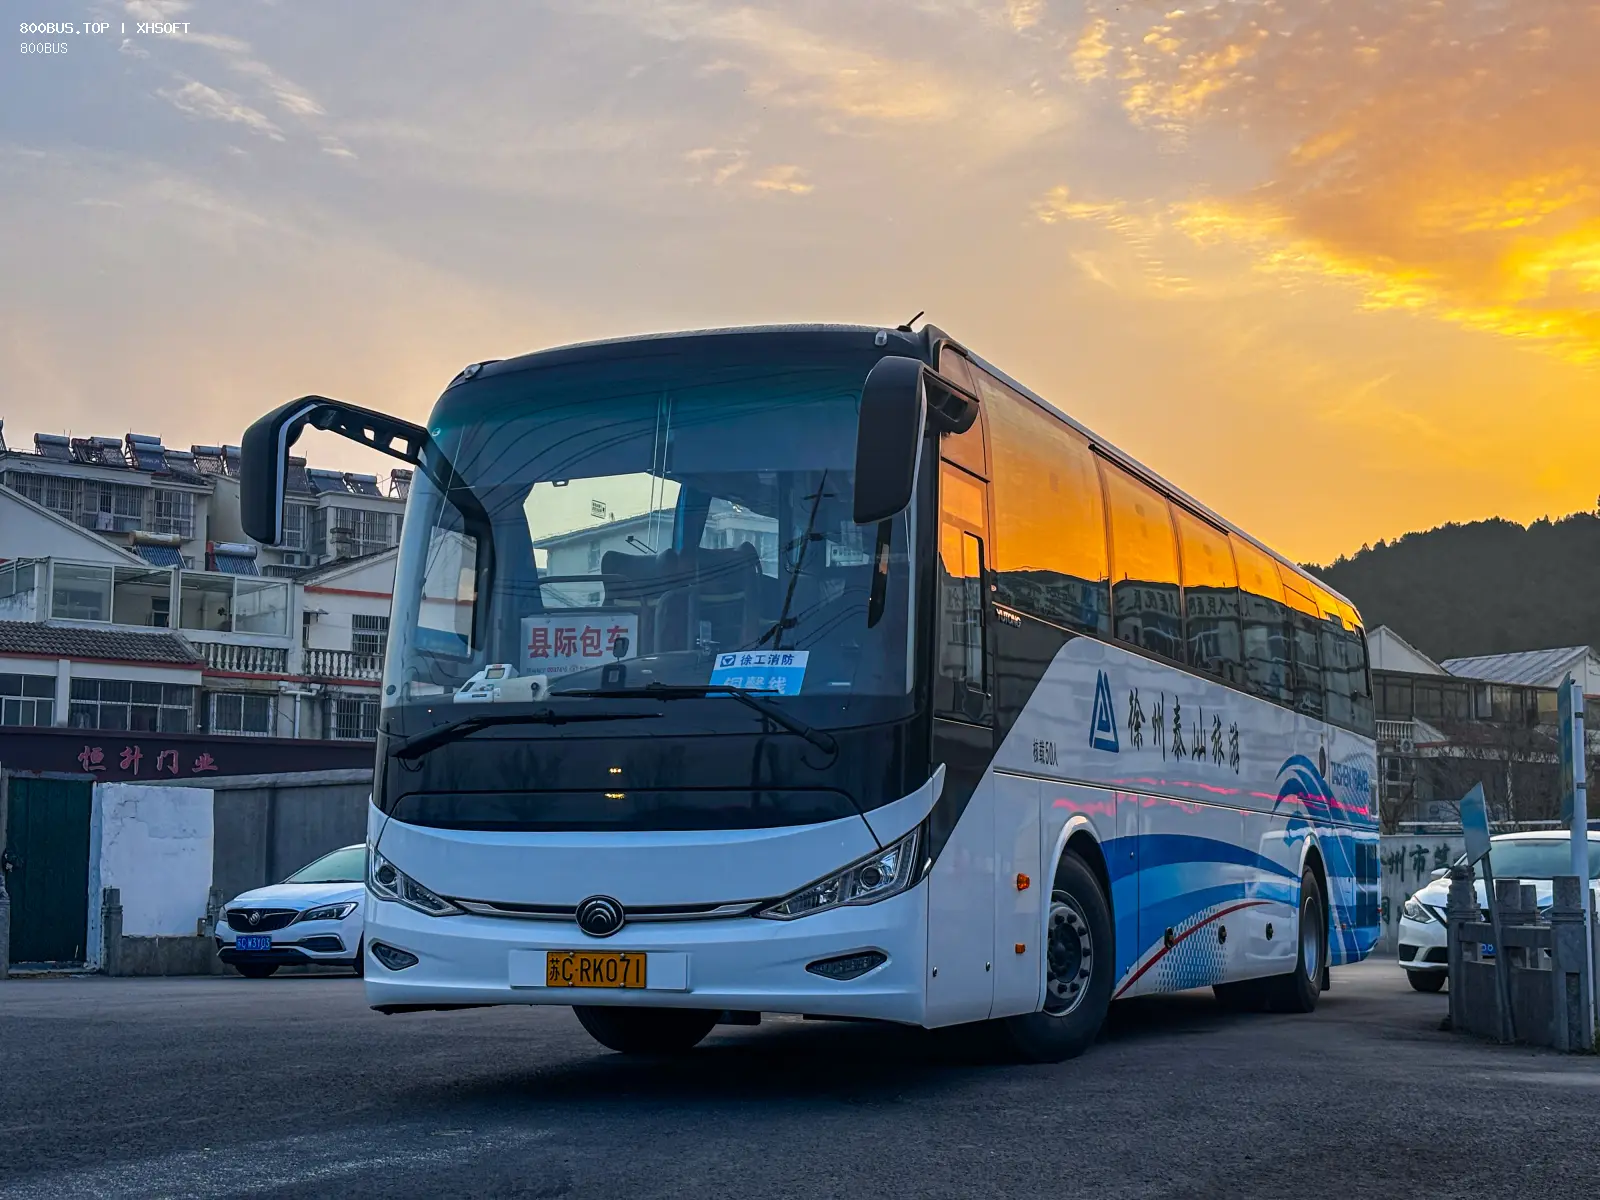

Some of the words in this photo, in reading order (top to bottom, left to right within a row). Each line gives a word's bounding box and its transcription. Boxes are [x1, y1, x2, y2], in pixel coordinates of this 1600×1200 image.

[527, 625, 629, 659] 县际包车
[740, 653, 795, 666] 徐工消防
[1127, 686, 1240, 775] 徐州泰山旅游
[77, 745, 219, 776] 恒升门业
